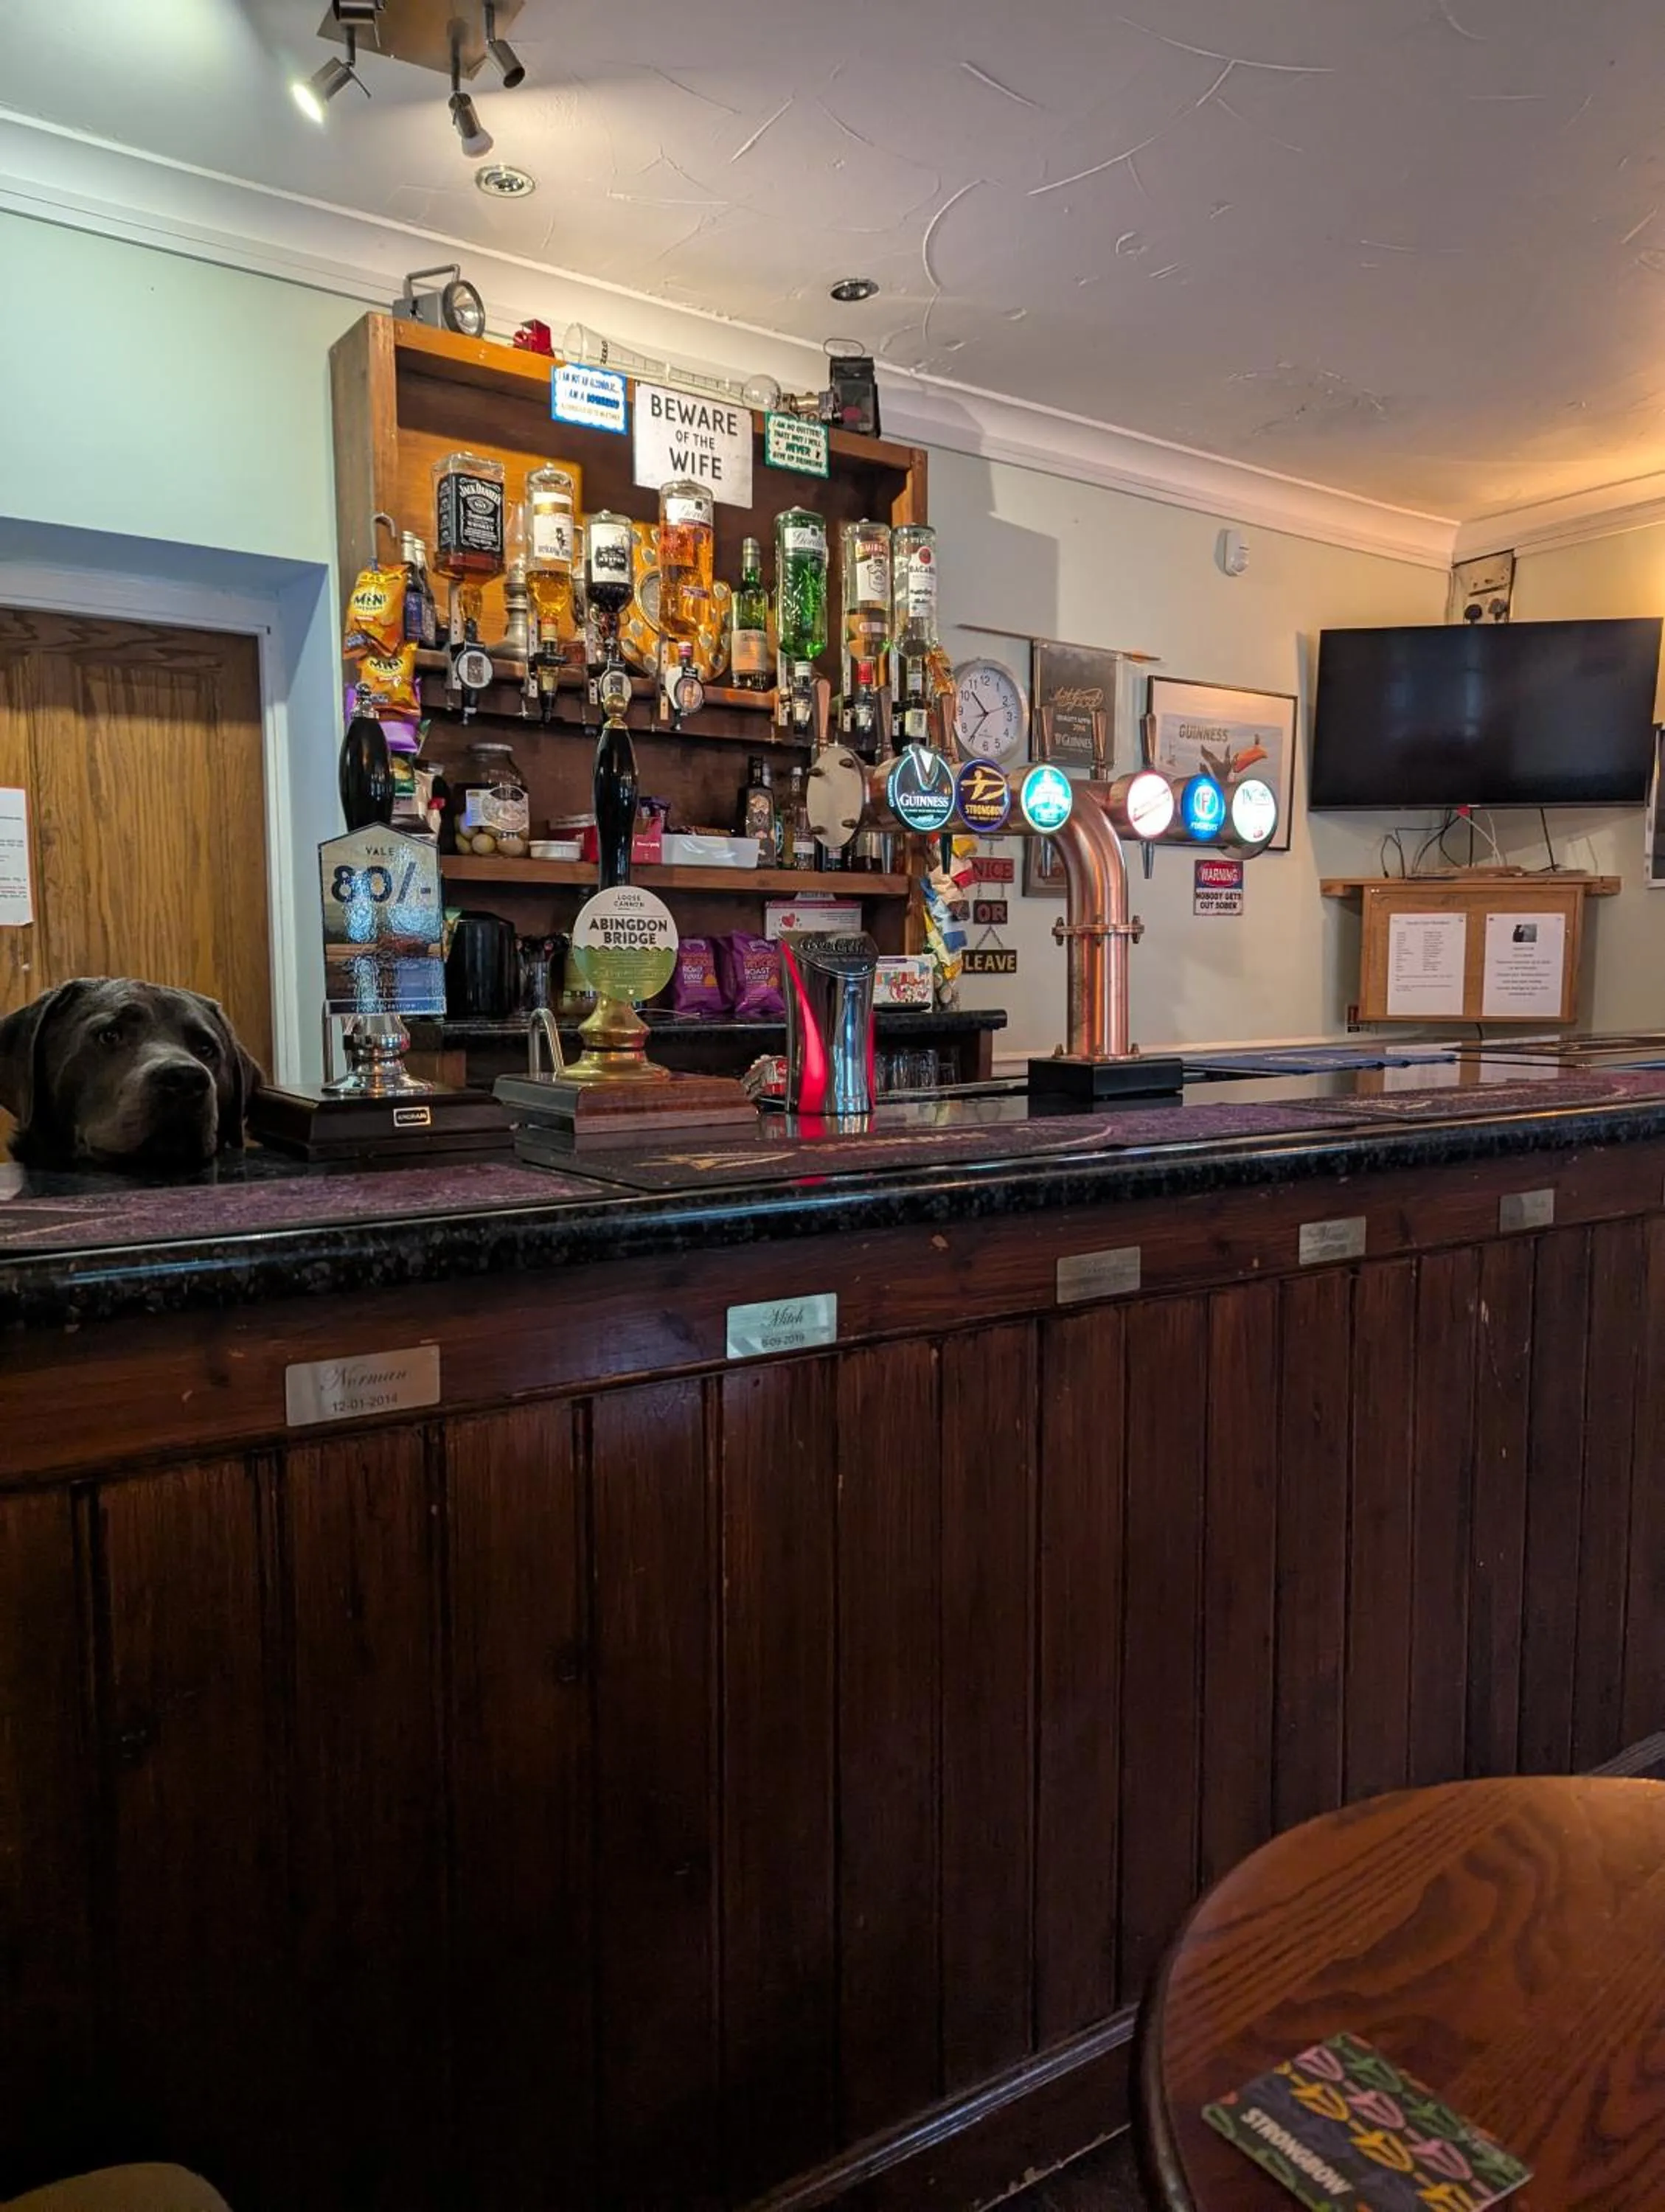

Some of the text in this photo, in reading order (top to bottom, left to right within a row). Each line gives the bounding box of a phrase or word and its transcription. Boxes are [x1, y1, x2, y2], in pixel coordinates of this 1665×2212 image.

[651, 394, 738, 437] BEWARE
[675, 429, 715, 450] OF THE
[670, 447, 723, 480] WIFE
[969, 679, 978, 690] 11
[980, 675, 990, 686] 12
[961, 689, 970, 700] 10
[1007, 712, 1012, 722] 3
[962, 722, 967, 733] 8
[1004, 728, 1009, 737] 4
[1179, 723, 1228, 742] GUINNESS
[982, 741, 989, 751] 6
[995, 738, 1001, 748] 5
[900, 792, 949, 807] GUINNESS
[366, 847, 394, 856] VALE
[973, 862, 1012, 880] NICE
[1201, 868, 1240, 881] WARNING
[1200, 901, 1214, 909] OUT
[977, 905, 1006, 922] OR
[590, 917, 667, 933] ABINGDON
[604, 931, 657, 945] BRIDGE
[965, 955, 1016, 971] LEAVE
[1241, 2106, 1354, 2196] STRONGBOW
